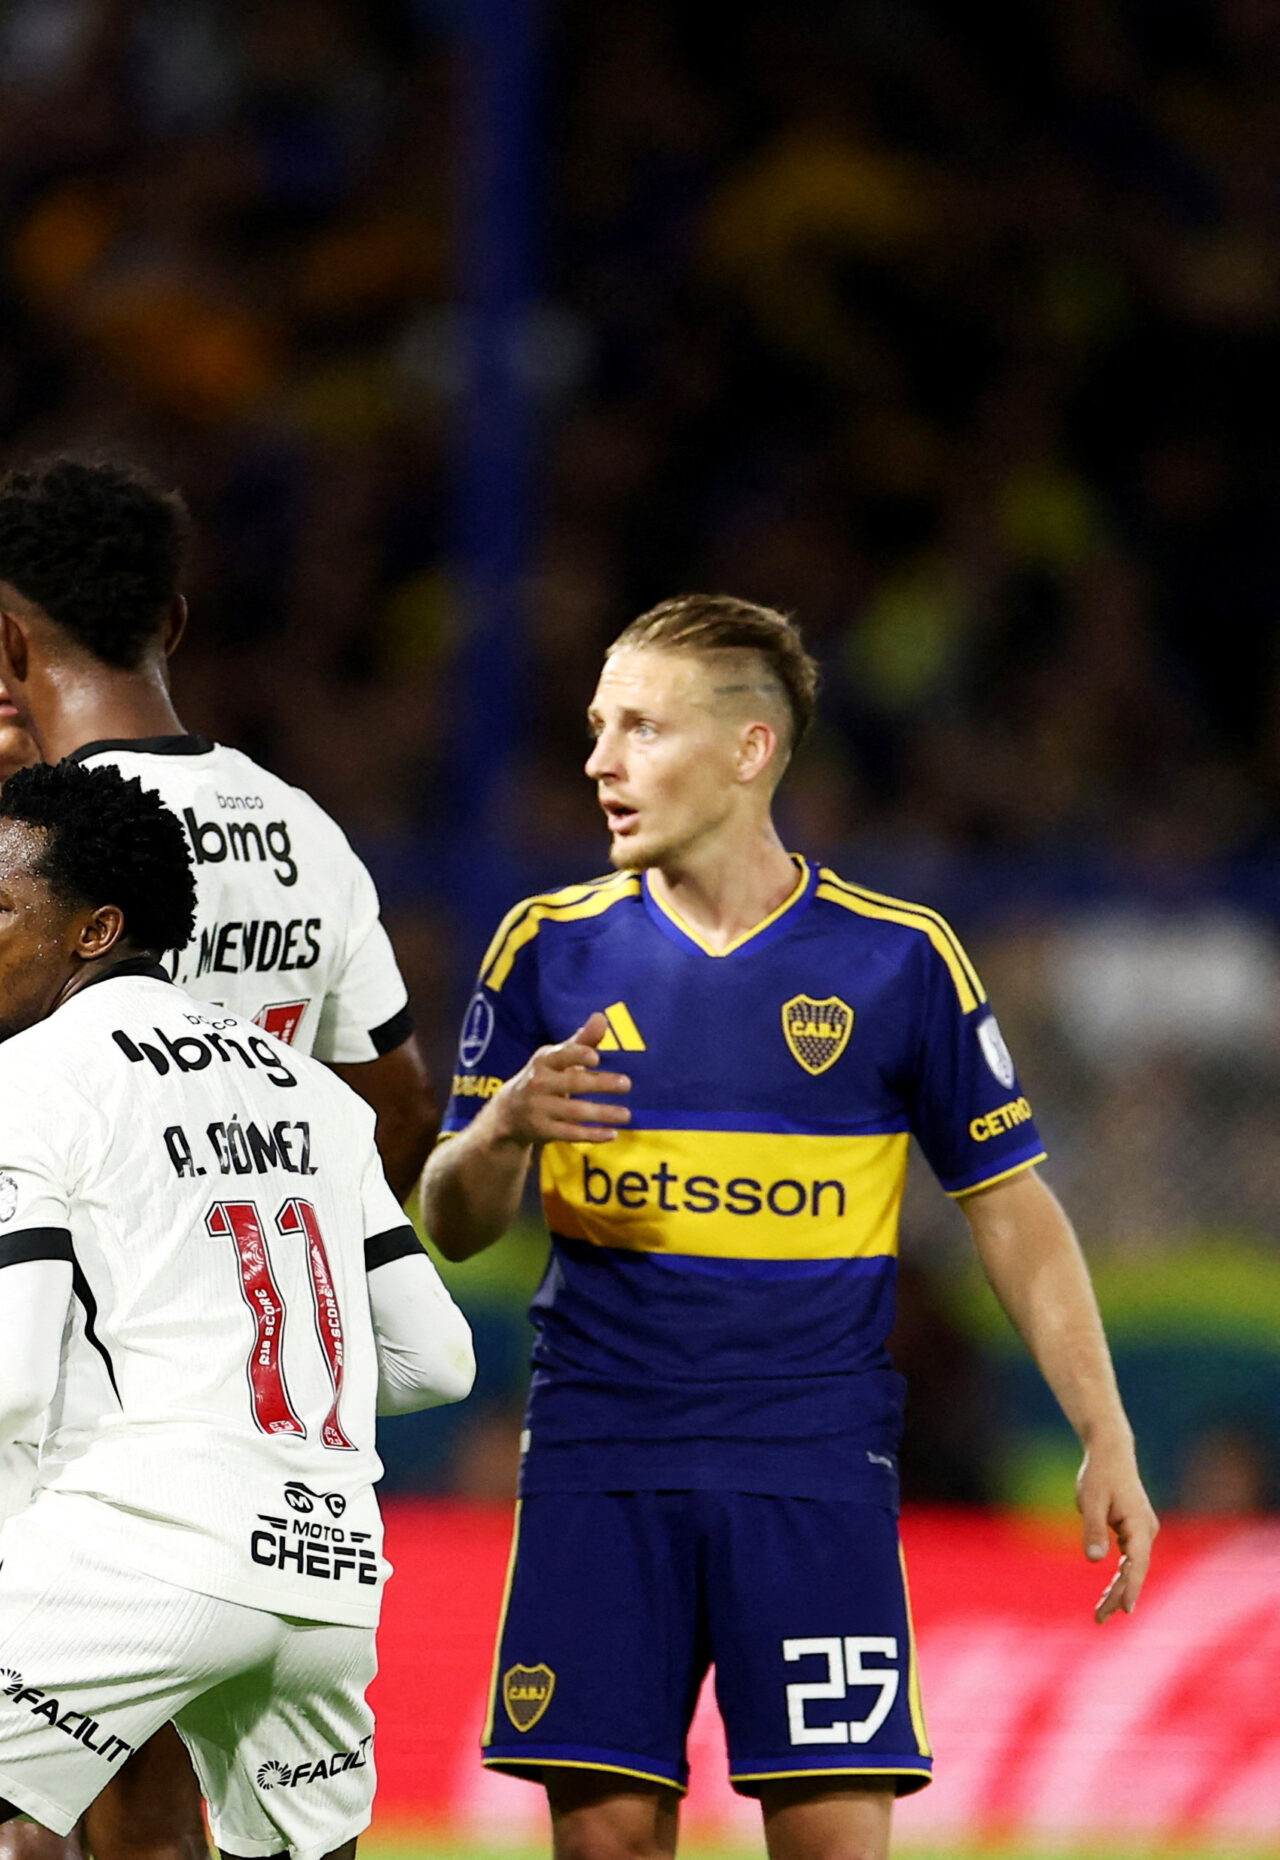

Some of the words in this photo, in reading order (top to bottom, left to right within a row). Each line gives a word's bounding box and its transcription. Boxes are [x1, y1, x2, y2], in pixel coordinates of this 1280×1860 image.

[216, 791, 264, 811] banco
[182, 807, 298, 887] bmg
[196, 918, 322, 978] MENDES
[152, 1026, 298, 1088] bmg
[163, 1125, 207, 1178] A.
[206, 1113, 319, 1176] GÓMEZ
[582, 1154, 846, 1218] betsson
[204, 1197, 360, 1452] 11
[254, 1288, 276, 1336] SCORE
[250, 1530, 378, 1585] CHEFE
[292, 1519, 345, 1543] MOTO
[782, 1636, 900, 1746] 25
[12, 1687, 135, 1763] FACILIT
